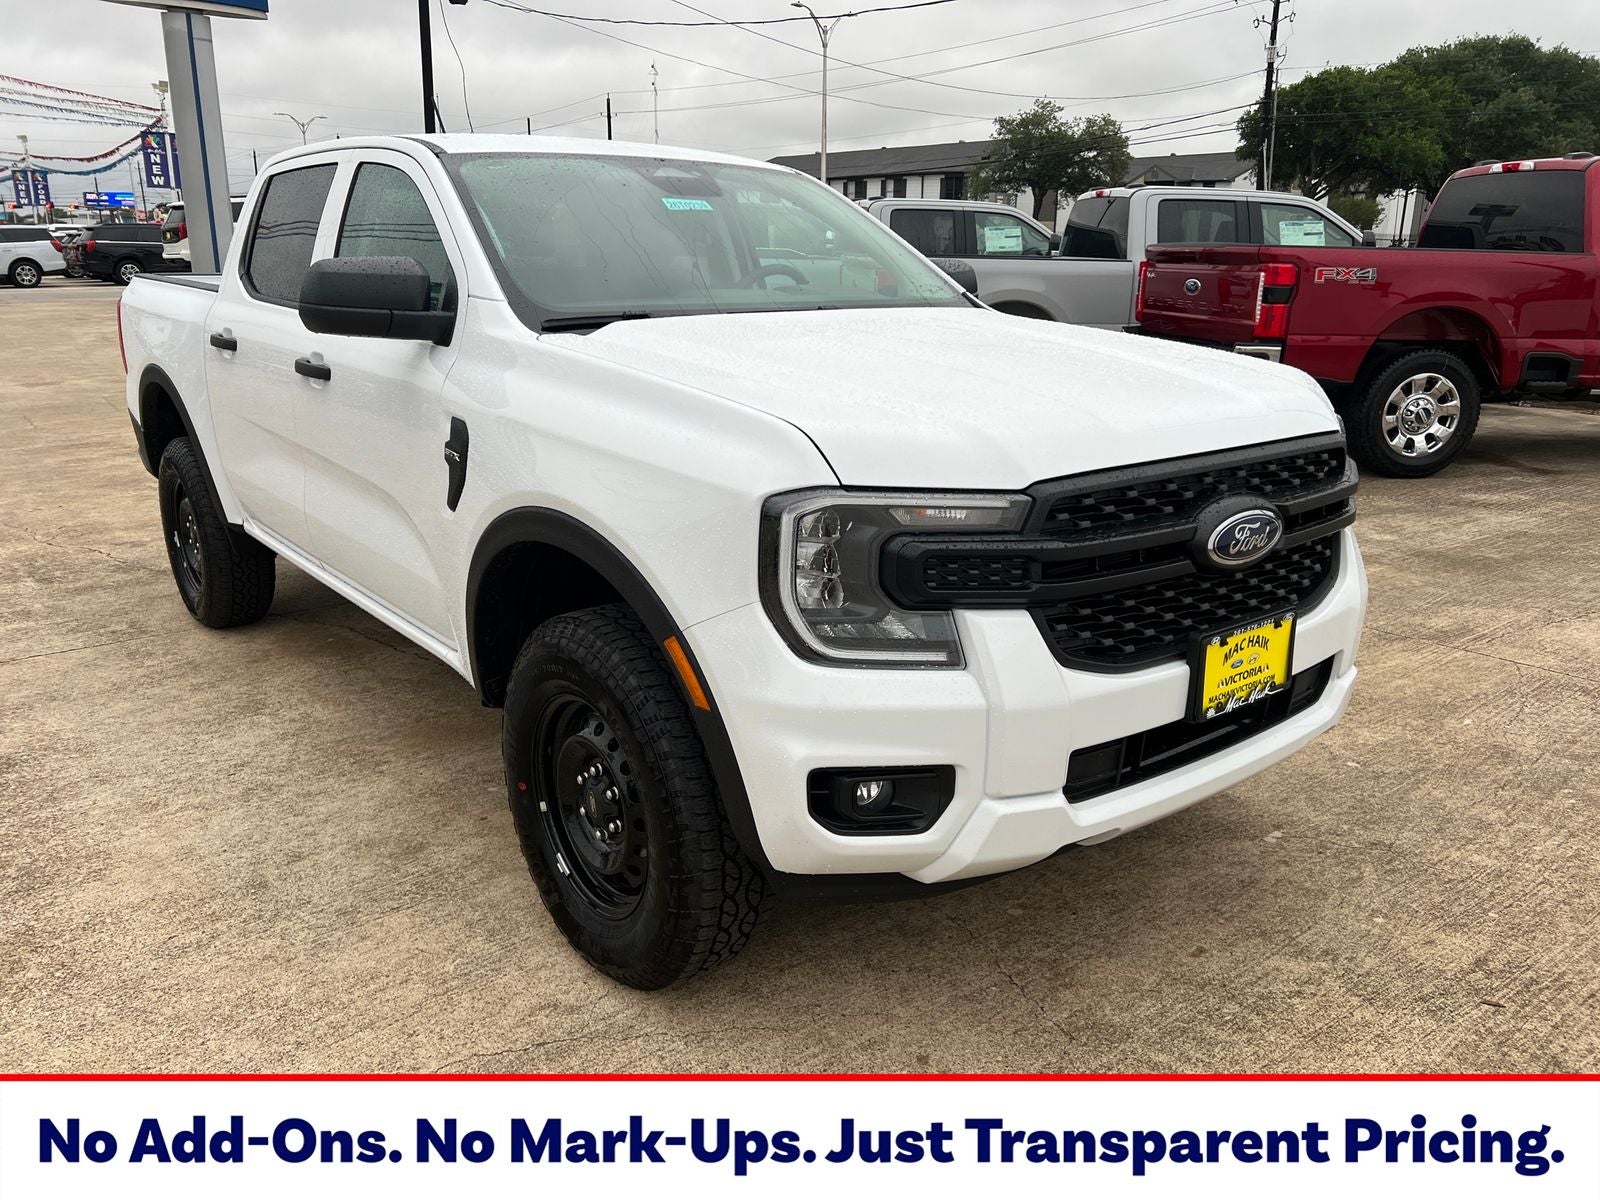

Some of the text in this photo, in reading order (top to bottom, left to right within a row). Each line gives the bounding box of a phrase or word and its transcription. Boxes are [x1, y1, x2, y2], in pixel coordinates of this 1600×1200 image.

[150, 154, 165, 186] NEW
[18, 184, 28, 204] NEW
[38, 184, 47, 204] FORD
[1314, 267, 1377, 282] FX4
[1147, 296, 1245, 313] SUPER DUTY
[1229, 521, 1270, 555] Ford
[1222, 634, 1270, 666] MAC HAIK
[1224, 665, 1263, 687] VICTORIA
[1225, 681, 1279, 713] Mac Haik
